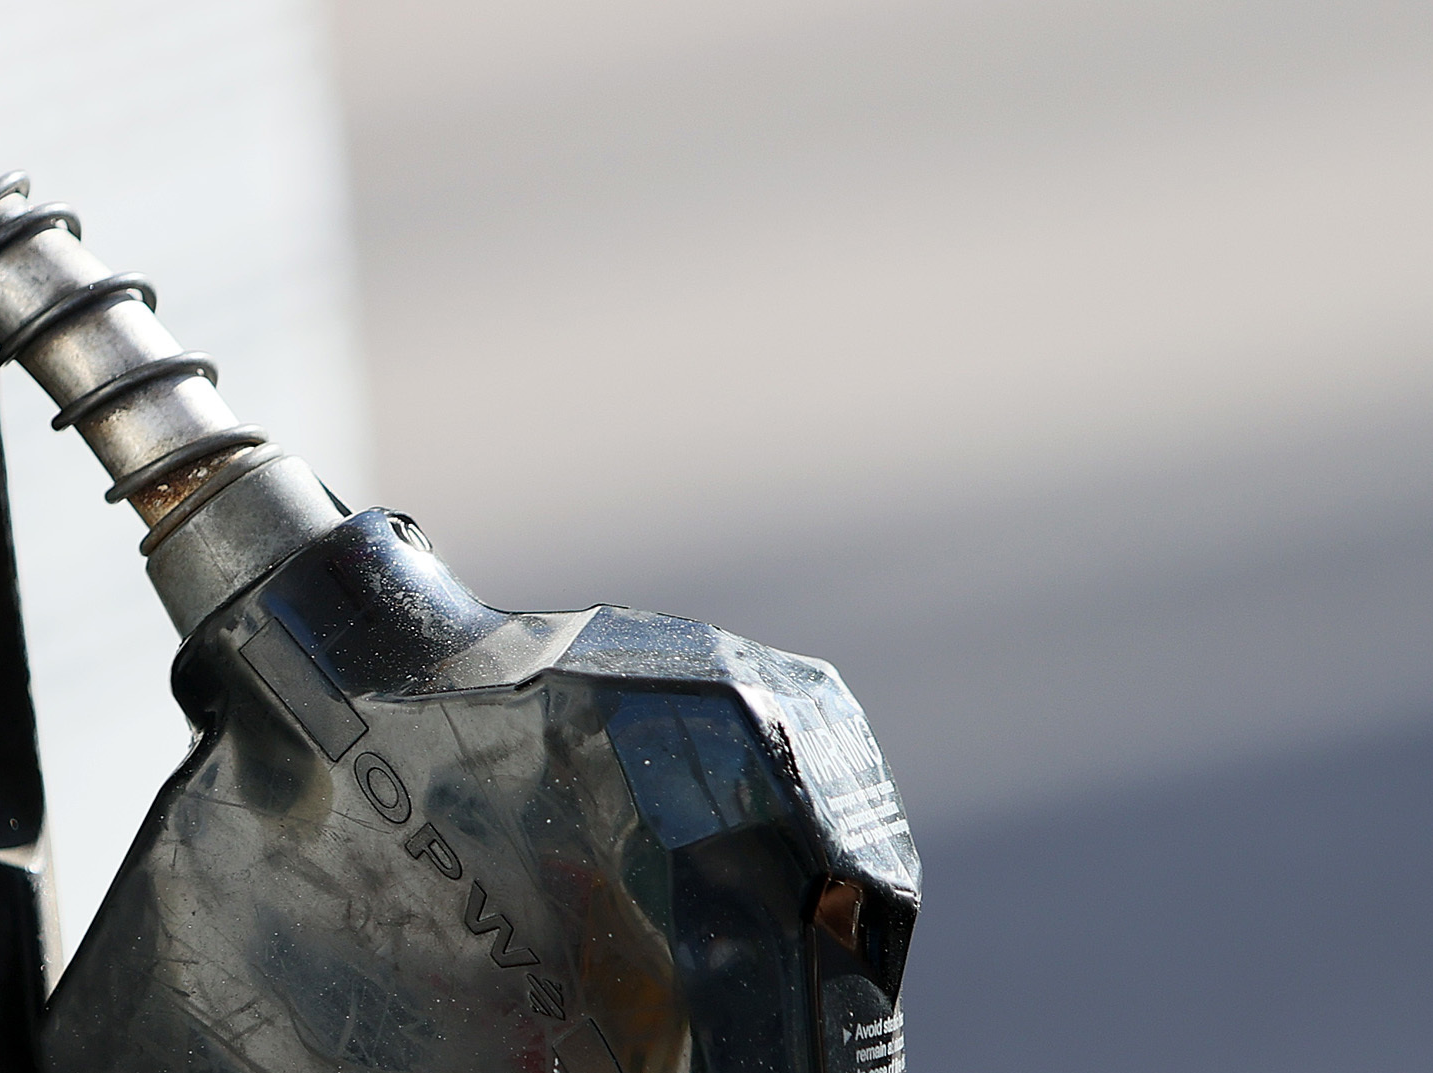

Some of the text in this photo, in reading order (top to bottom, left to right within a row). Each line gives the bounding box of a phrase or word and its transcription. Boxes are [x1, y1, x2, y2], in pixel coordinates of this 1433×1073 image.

[796, 714, 883, 785] WARNING
[354, 752, 540, 968] OPW
[855, 1018, 882, 1040] Avoid
[856, 1041, 887, 1063] remain
